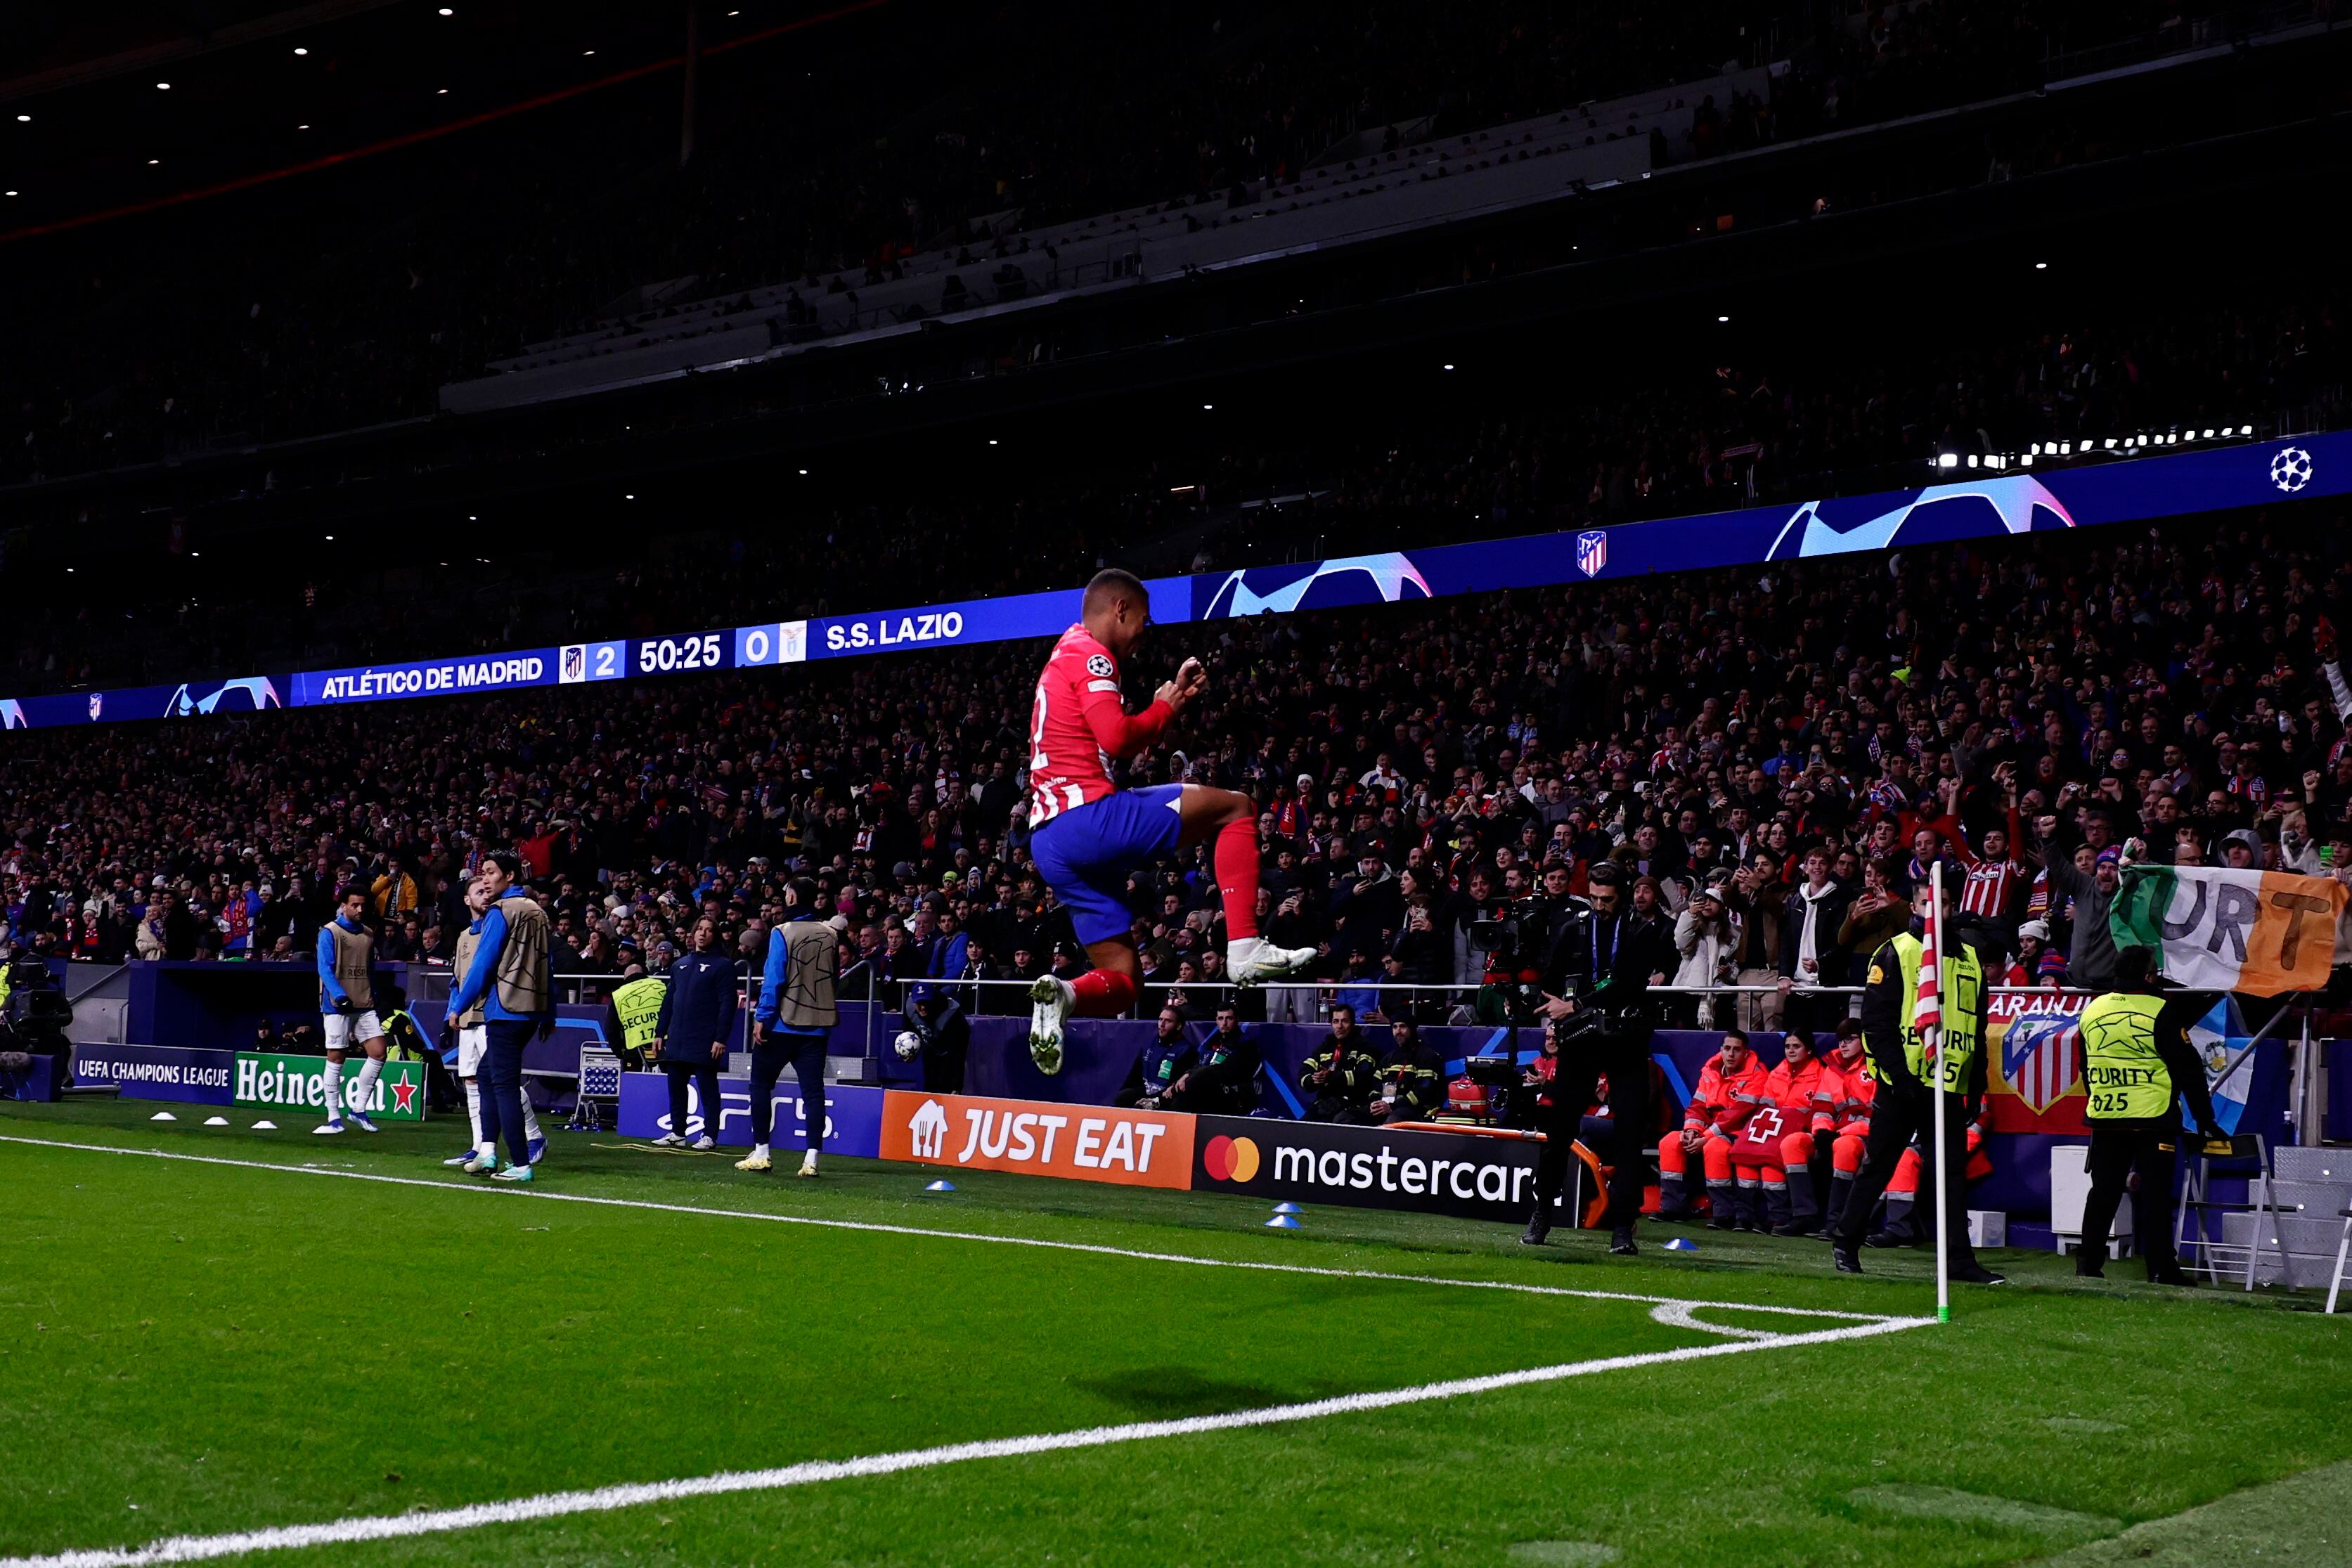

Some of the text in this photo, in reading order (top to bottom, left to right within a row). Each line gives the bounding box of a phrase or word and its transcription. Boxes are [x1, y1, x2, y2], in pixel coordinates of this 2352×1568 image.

[746, 630, 769, 662] 0
[827, 611, 962, 650] S.S. LAZIO
[595, 647, 615, 675] 2
[640, 635, 721, 672] 50:25
[322, 658, 543, 699] ATLÉTICO DE MADRID
[79, 1059, 228, 1087] UEFA CHAMPIONS LEAGUE
[957, 1108, 1165, 1172] JUST EAT
